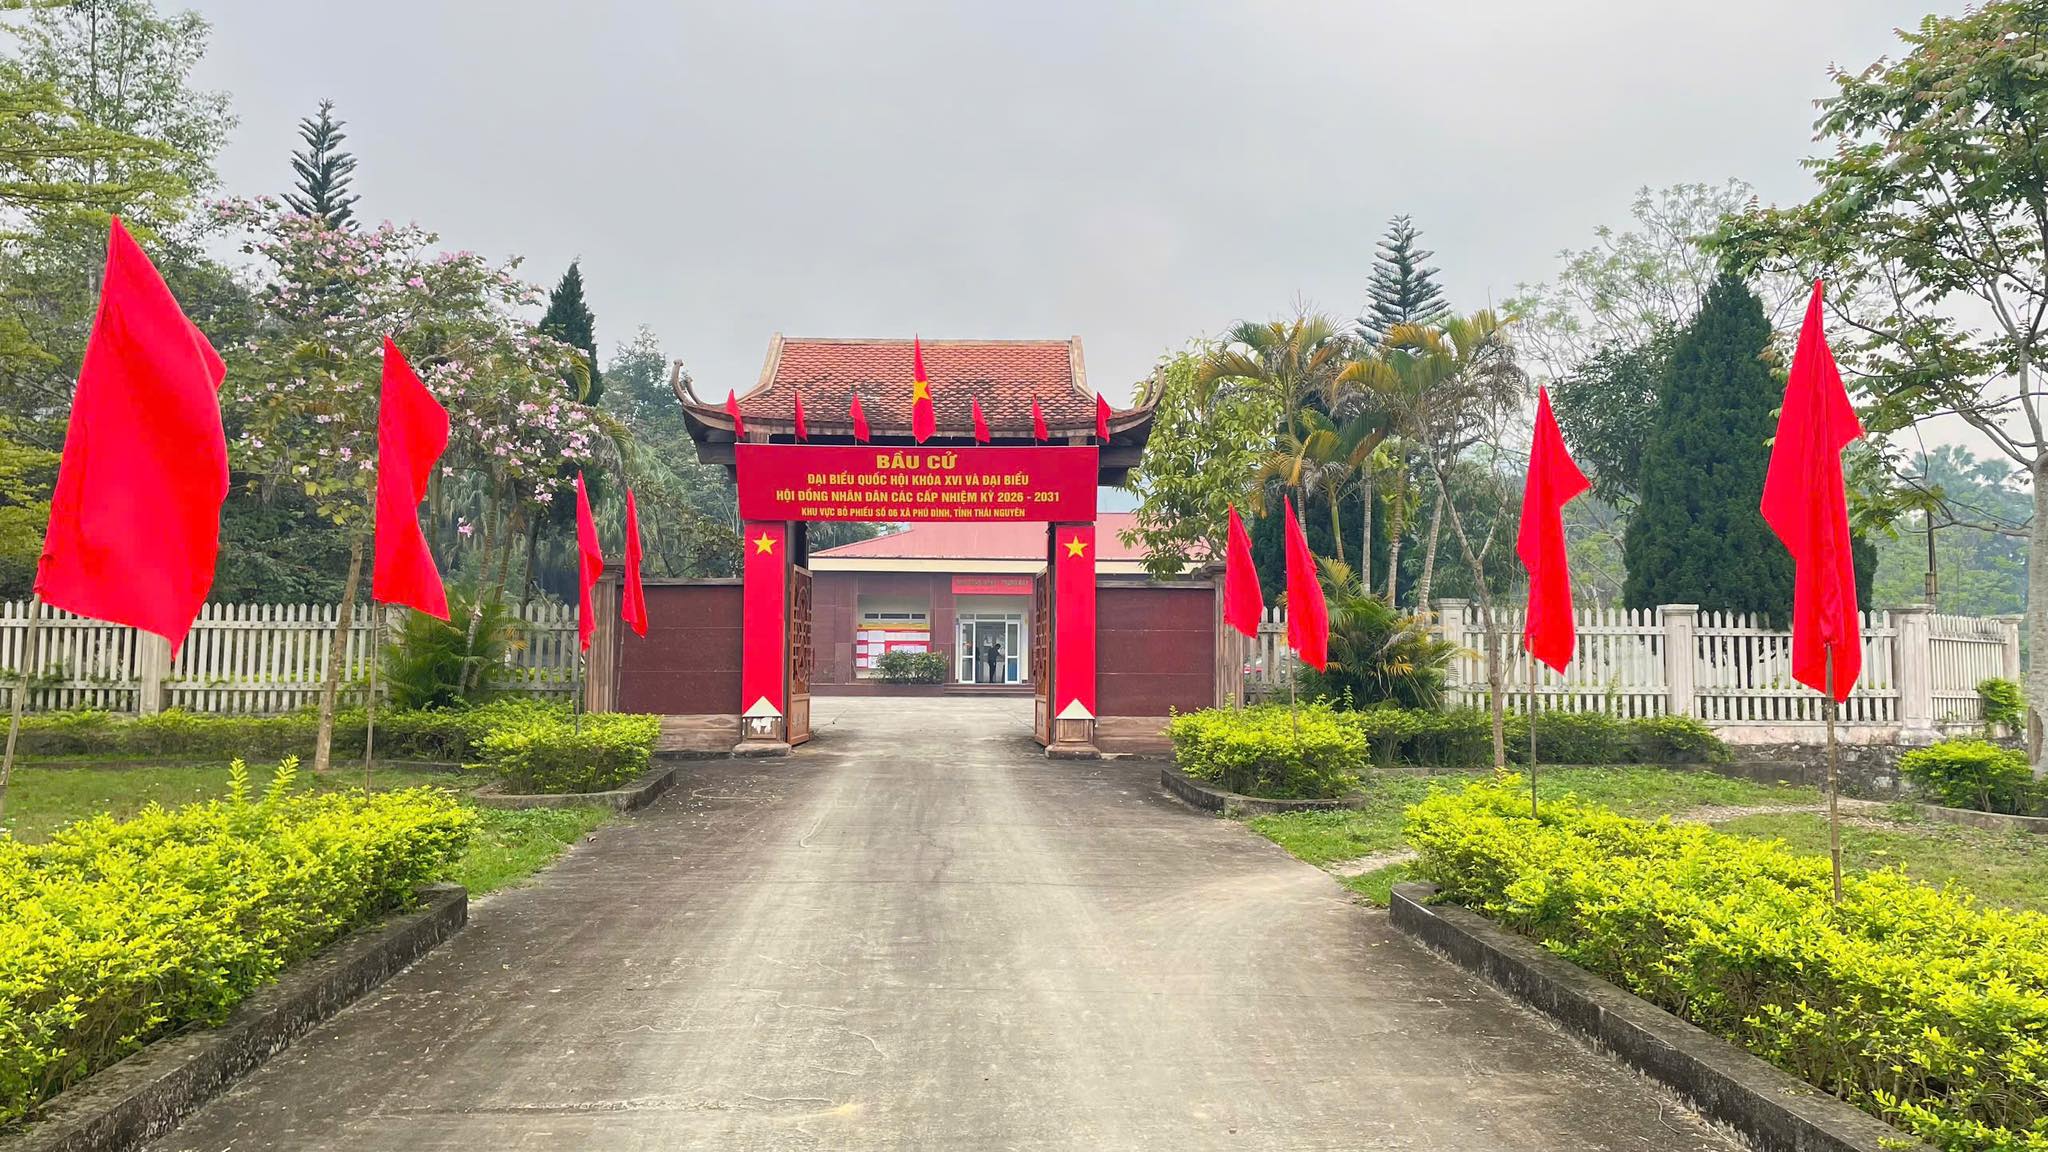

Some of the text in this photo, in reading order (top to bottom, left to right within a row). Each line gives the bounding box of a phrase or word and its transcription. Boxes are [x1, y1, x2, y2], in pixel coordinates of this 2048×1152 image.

[877, 450, 958, 469] BẦU CỬ
[808, 471, 1028, 488] ĐẠI BIỂU QUỐC HỘI KHÓA XVI VÀ ĐẠI BIỂU
[776, 488, 795, 503] HỘI
[831, 490, 862, 502] NHÂN
[865, 490, 888, 502] DÂN
[891, 490, 914, 502] CÁC
[916, 488, 938, 502] CẤP
[942, 491, 977, 504] NHIỆM
[981, 489, 995, 503] KỲ
[998, 491, 1024, 503] 2026
[1034, 492, 1060, 502] 2031
[801, 508, 817, 516] KHU
[819, 508, 835, 518] VỰC
[850, 506, 873, 517] PHIẾU
[875, 507, 886, 517] SỐ
[888, 508, 898, 517] 06
[974, 507, 991, 517] THÁI
[994, 507, 1025, 517] NGUYÊN
